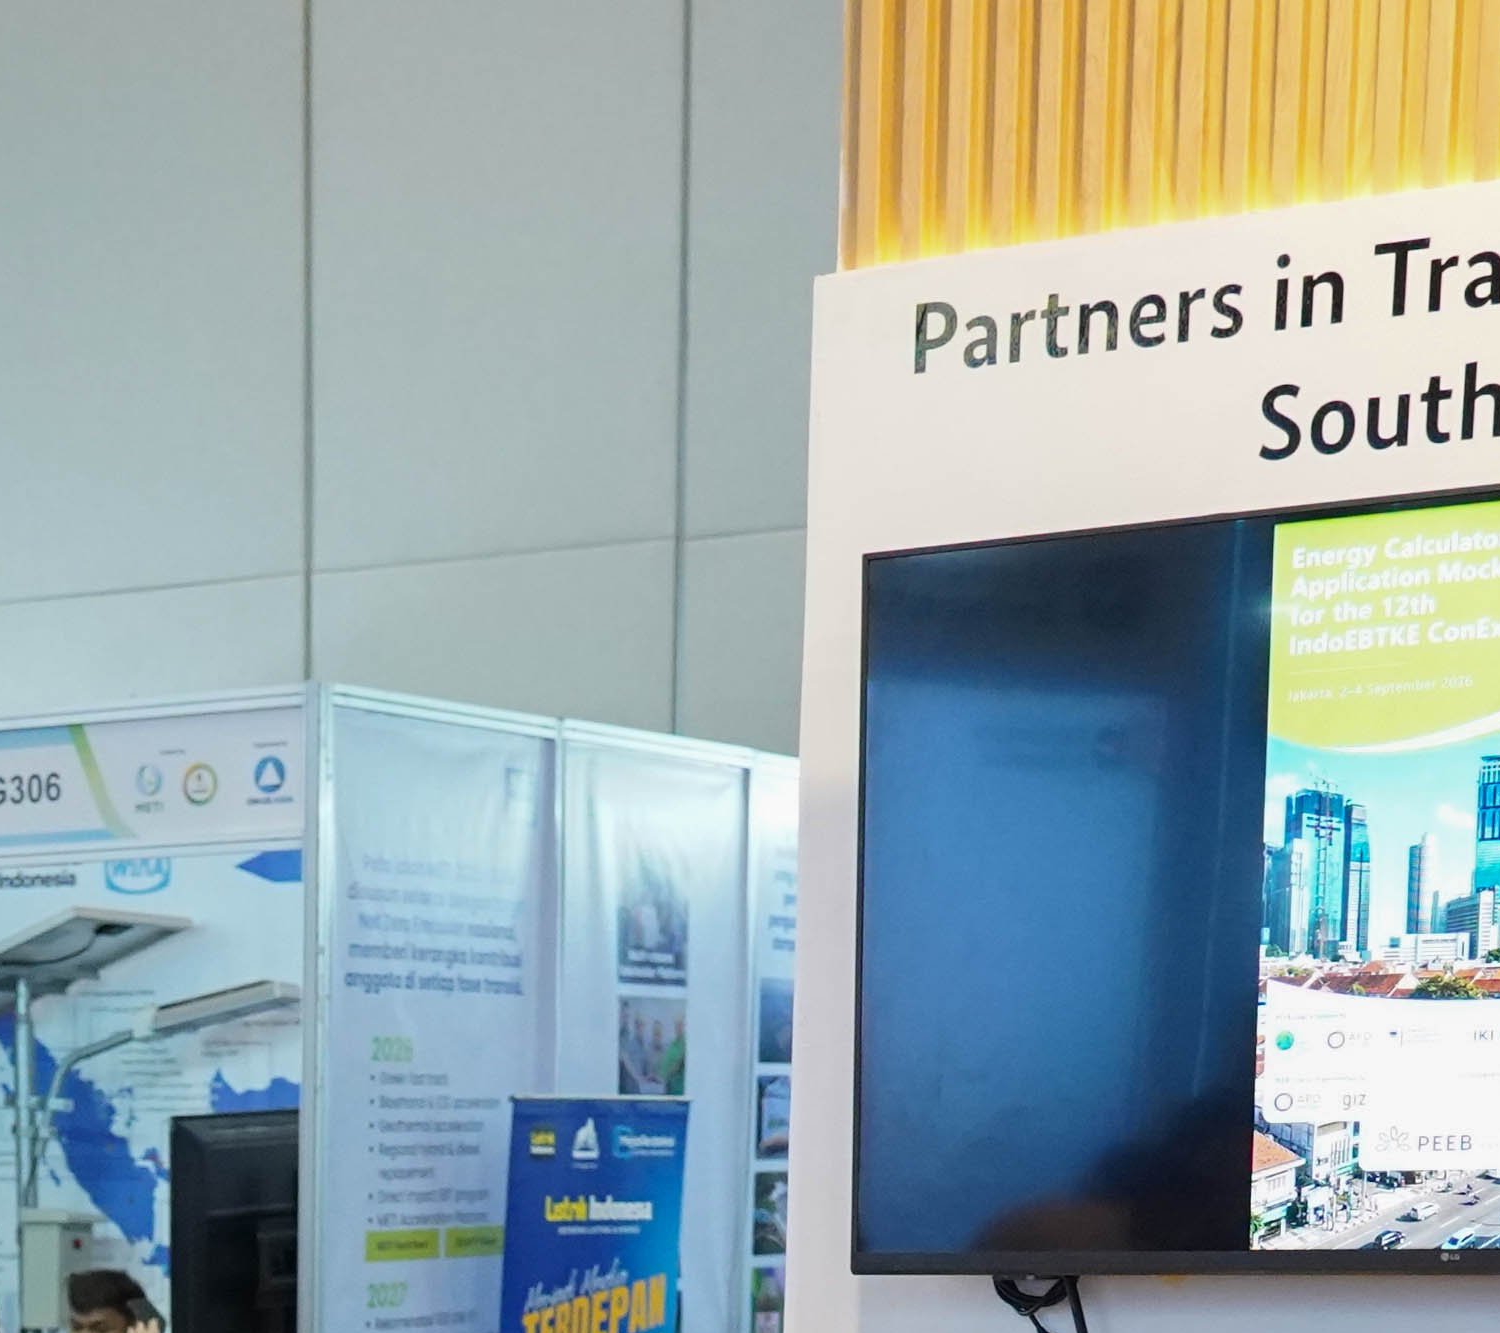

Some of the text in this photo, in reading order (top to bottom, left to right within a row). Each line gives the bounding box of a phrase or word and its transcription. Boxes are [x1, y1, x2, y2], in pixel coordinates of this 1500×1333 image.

[914, 284, 1242, 373] Partners
[1274, 254, 1344, 330] in
[1292, 545, 1376, 571] Energy
[1292, 567, 1430, 599] Application
[1289, 593, 1434, 625] for the 12th
[1290, 623, 1419, 654] IndoEBTKE
[1473, 1030, 1494, 1041] IKI
[1342, 1093, 1367, 1111] giz
[1417, 1135, 1472, 1152] PEEB
